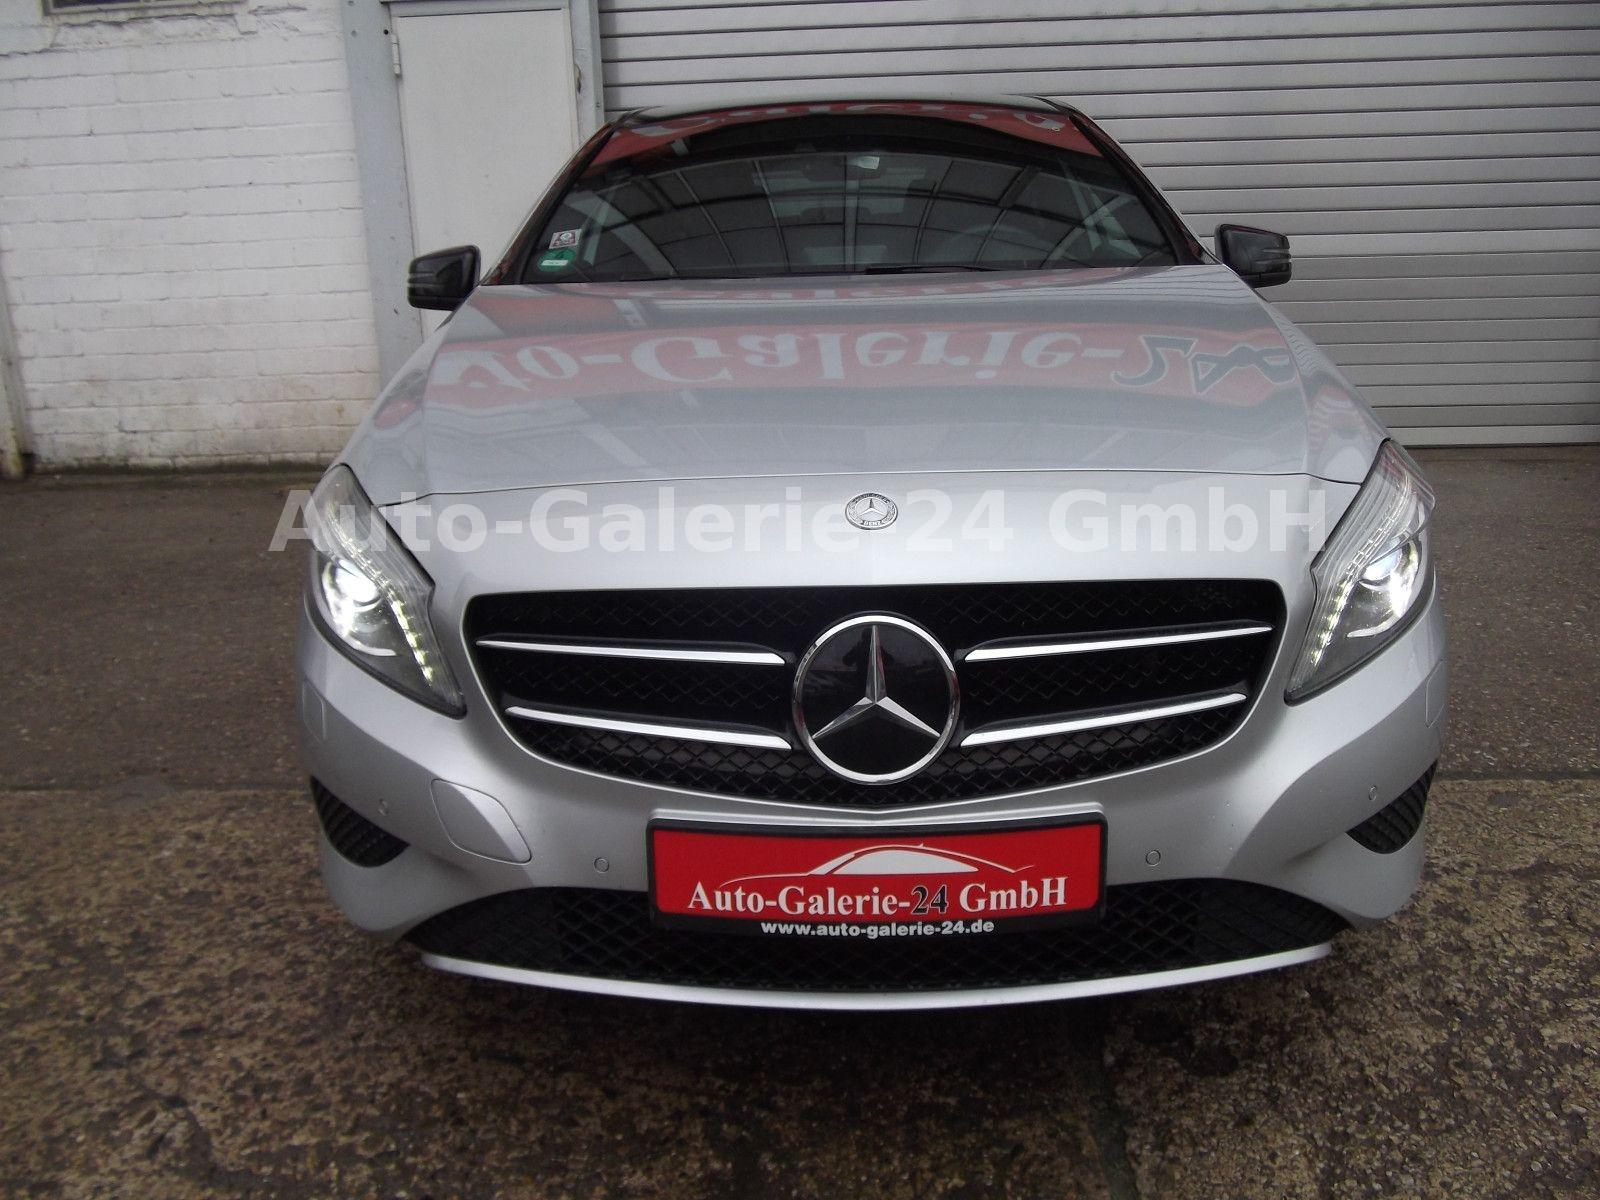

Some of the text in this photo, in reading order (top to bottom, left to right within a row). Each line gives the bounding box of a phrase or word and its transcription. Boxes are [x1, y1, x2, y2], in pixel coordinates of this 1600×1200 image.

[687, 876, 1069, 916] Auto-Galerie-24 GmbH
[760, 919, 995, 940] www.auto-galerie-24.de
